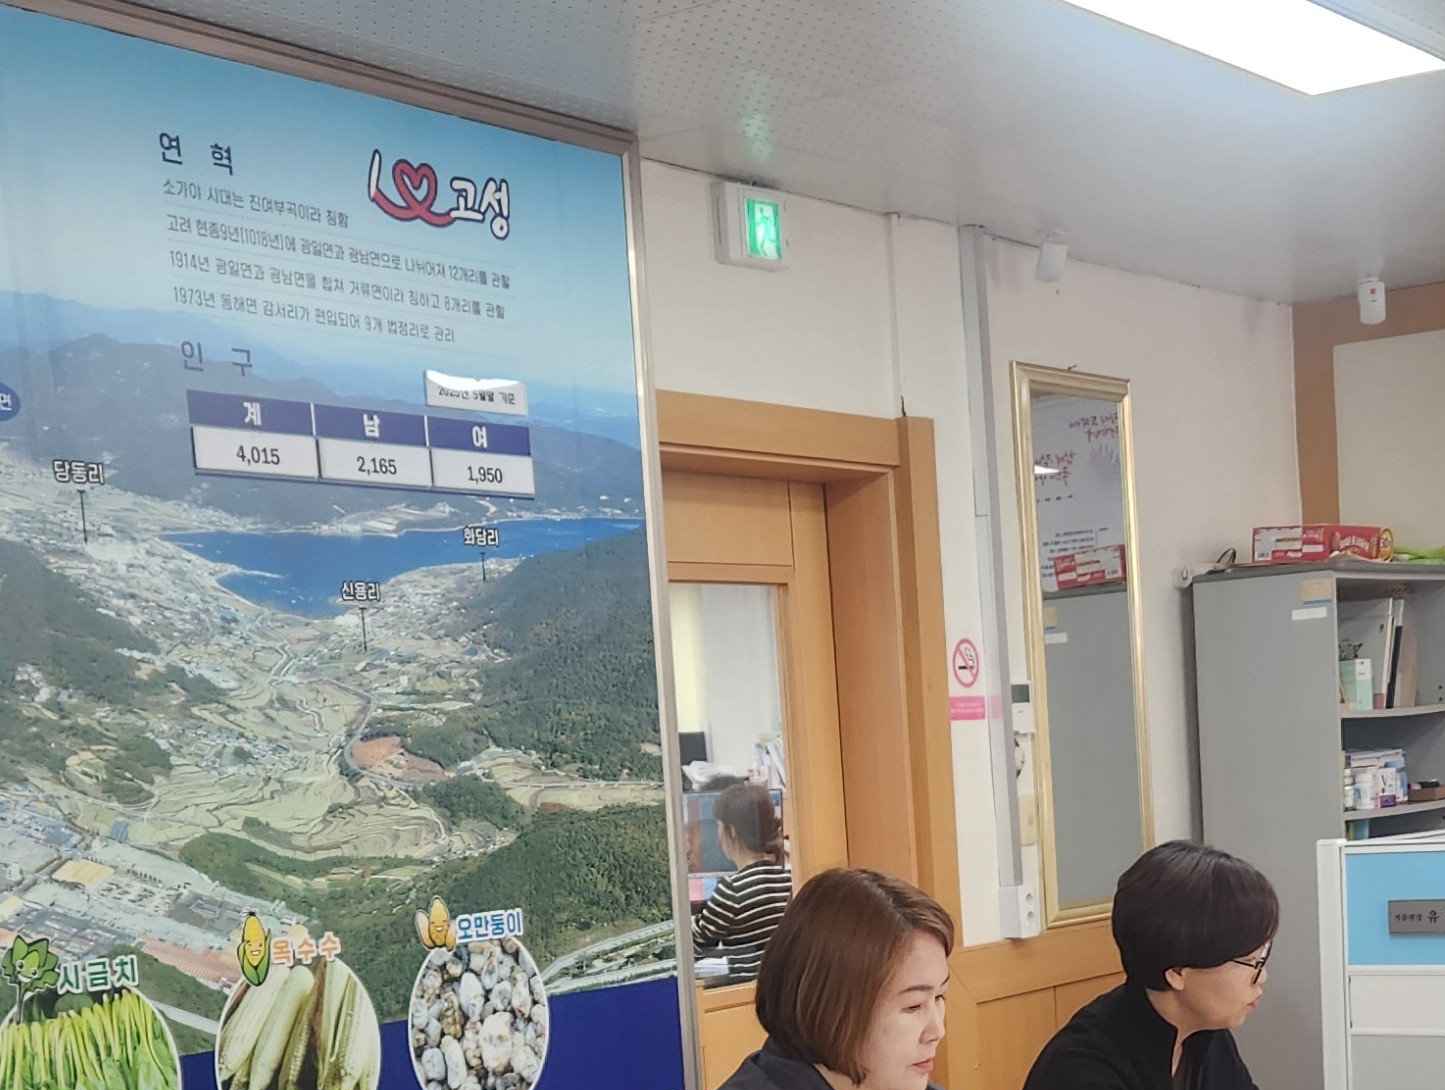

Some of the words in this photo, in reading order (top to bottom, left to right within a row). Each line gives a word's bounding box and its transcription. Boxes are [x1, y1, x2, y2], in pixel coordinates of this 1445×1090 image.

[159, 132, 183, 166] 연
[210, 143, 234, 176] 혁
[162, 178, 202, 201] 소가야
[207, 186, 245, 209] 시대는
[449, 176, 510, 240] 고성
[166, 213, 192, 235] 고려
[170, 250, 210, 273] 1914년
[173, 286, 216, 309] 1973년
[220, 293, 258, 315] 동해면
[434, 325, 455, 344] 관리
[181, 340, 204, 372] 인
[231, 347, 253, 377] 구
[243, 401, 262, 427] 계
[362, 413, 381, 438] 남
[471, 425, 488, 448] 여
[53, 459, 105, 485] 당동리
[236, 445, 281, 467] 4,015
[356, 455, 398, 476] 2,165
[466, 465, 504, 485] 1,950
[463, 526, 499, 547] 화당리
[341, 580, 381, 602] 신용리
[457, 910, 522, 941] 오만둥이
[1427, 909, 1440, 924] 유
[271, 933, 341, 966] 옥수수
[58, 955, 138, 994] 시금치
